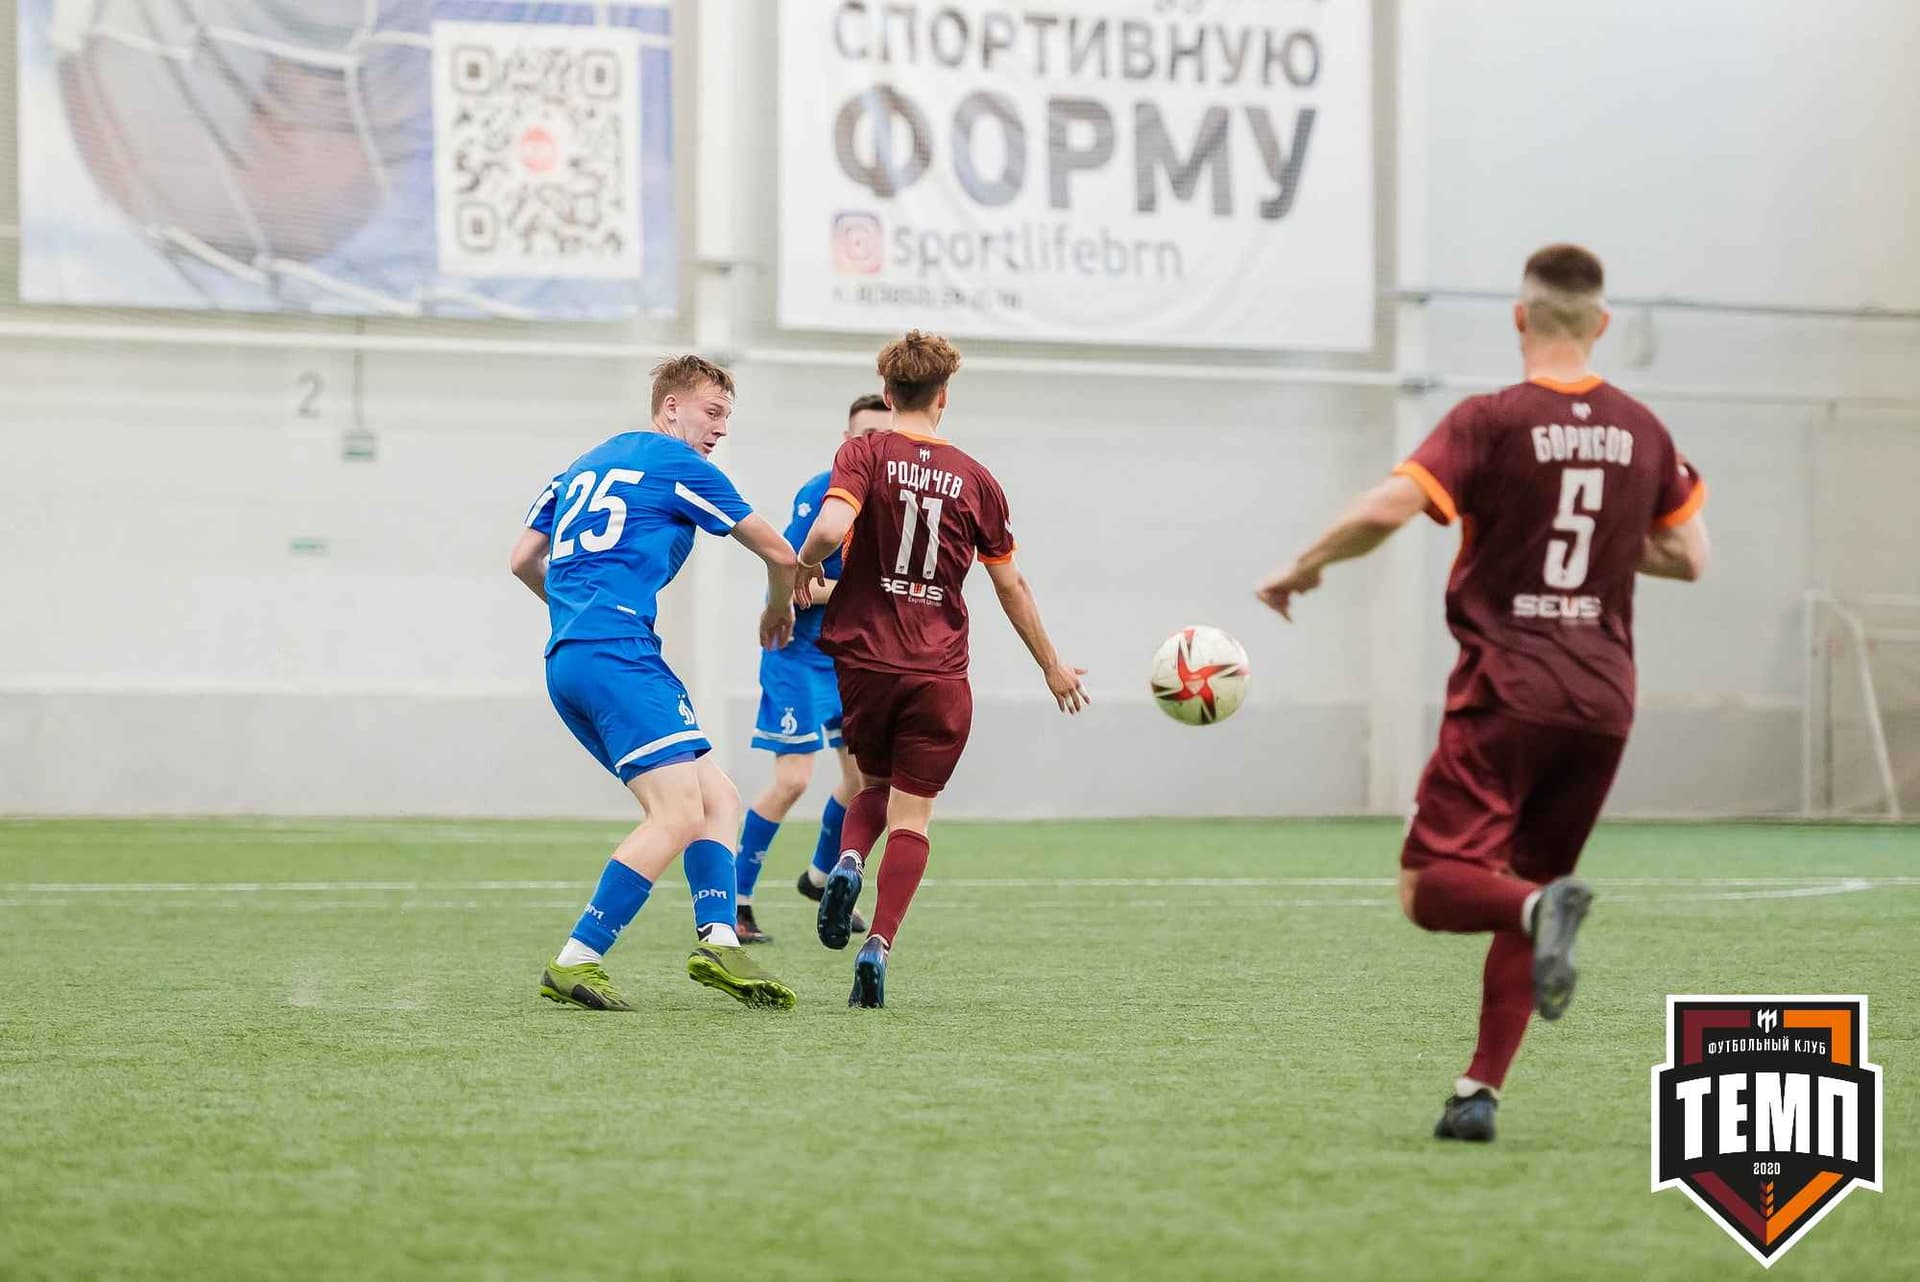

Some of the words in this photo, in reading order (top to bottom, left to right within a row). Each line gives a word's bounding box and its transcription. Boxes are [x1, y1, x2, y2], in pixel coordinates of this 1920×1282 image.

[833, 2, 1322, 88] СПОРТИВНУЮ
[834, 84, 1318, 220] ФОРМУ
[893, 222, 1185, 279] sportlifebrn
[297, 370, 325, 419] 2
[887, 460, 963, 499] РОДИЧЕВ
[1531, 424, 1634, 467] БОРИСОВ
[551, 468, 645, 561] 25
[895, 489, 943, 580] 11
[1543, 467, 1605, 589] 5
